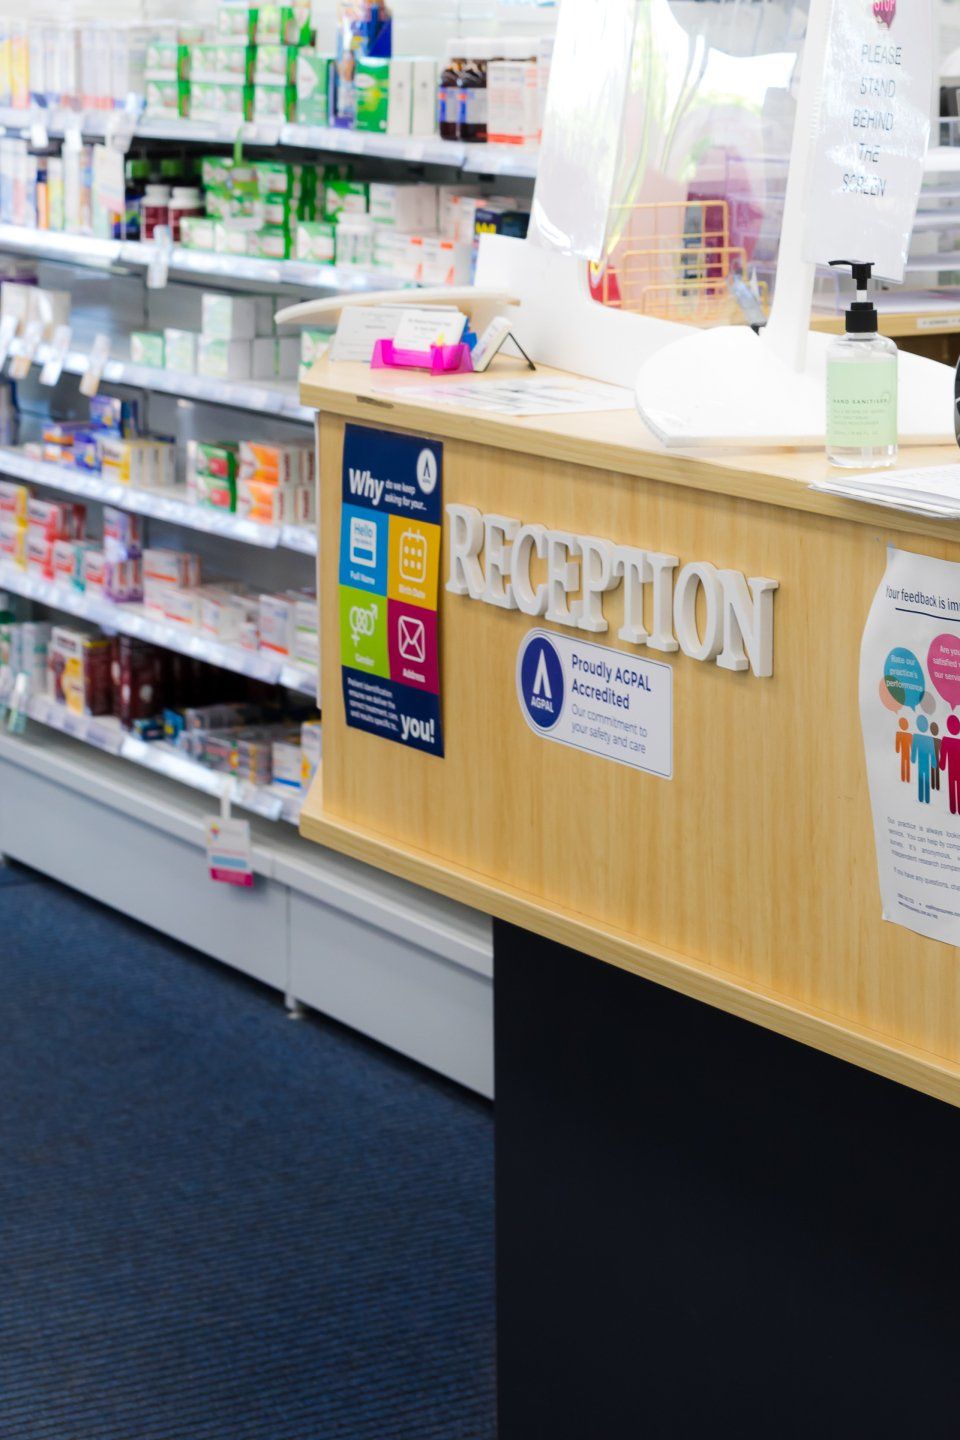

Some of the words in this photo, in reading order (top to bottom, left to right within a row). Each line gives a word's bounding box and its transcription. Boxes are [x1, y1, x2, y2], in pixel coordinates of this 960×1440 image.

[861, 44, 902, 66] PLEASE
[860, 77, 895, 98] STAND
[853, 109, 893, 131] BEHIND
[858, 142, 879, 163] THE
[349, 468, 384, 506] Why
[354, 523, 373, 538] Hello
[446, 503, 779, 678] RECEPTION
[901, 589, 938, 608] feedback
[939, 597, 946, 609] is
[940, 646, 949, 655] Are
[572, 654, 612, 683] Proudly
[615, 667, 651, 692] AGPAL
[933, 657, 957, 668] satisfied
[934, 671, 944, 679] our
[531, 696, 554, 713] AGPAL
[572, 678, 629, 710] Accredited
[400, 713, 435, 744] you!
[572, 703, 586, 718] Our
[588, 710, 636, 734] commitment
[639, 726, 647, 738] to
[571, 722, 587, 734] your
[590, 724, 611, 744] safety
[613, 734, 627, 747] and
[630, 739, 646, 754] care
